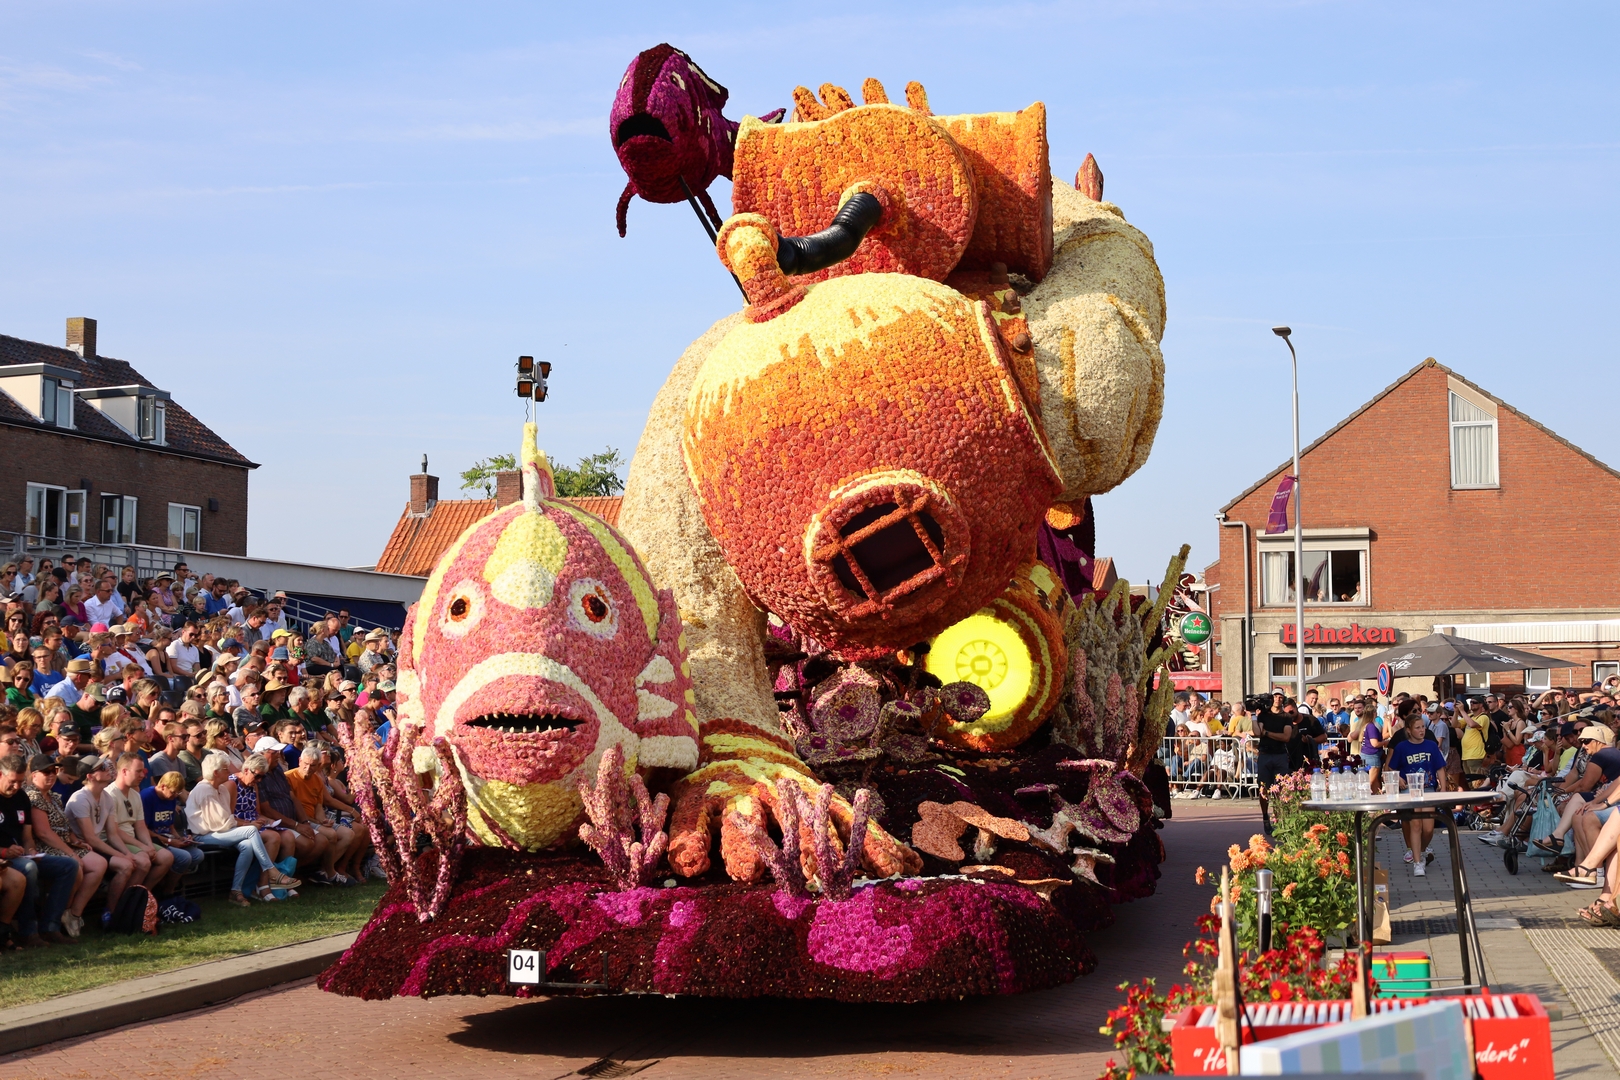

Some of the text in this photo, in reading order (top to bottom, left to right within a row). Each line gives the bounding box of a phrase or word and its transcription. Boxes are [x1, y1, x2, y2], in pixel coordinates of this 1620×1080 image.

[1281, 623, 1397, 643] Heineken
[1406, 752, 1431, 765] BEET
[154, 810, 174, 822] BEET
[513, 954, 535, 971] 04
